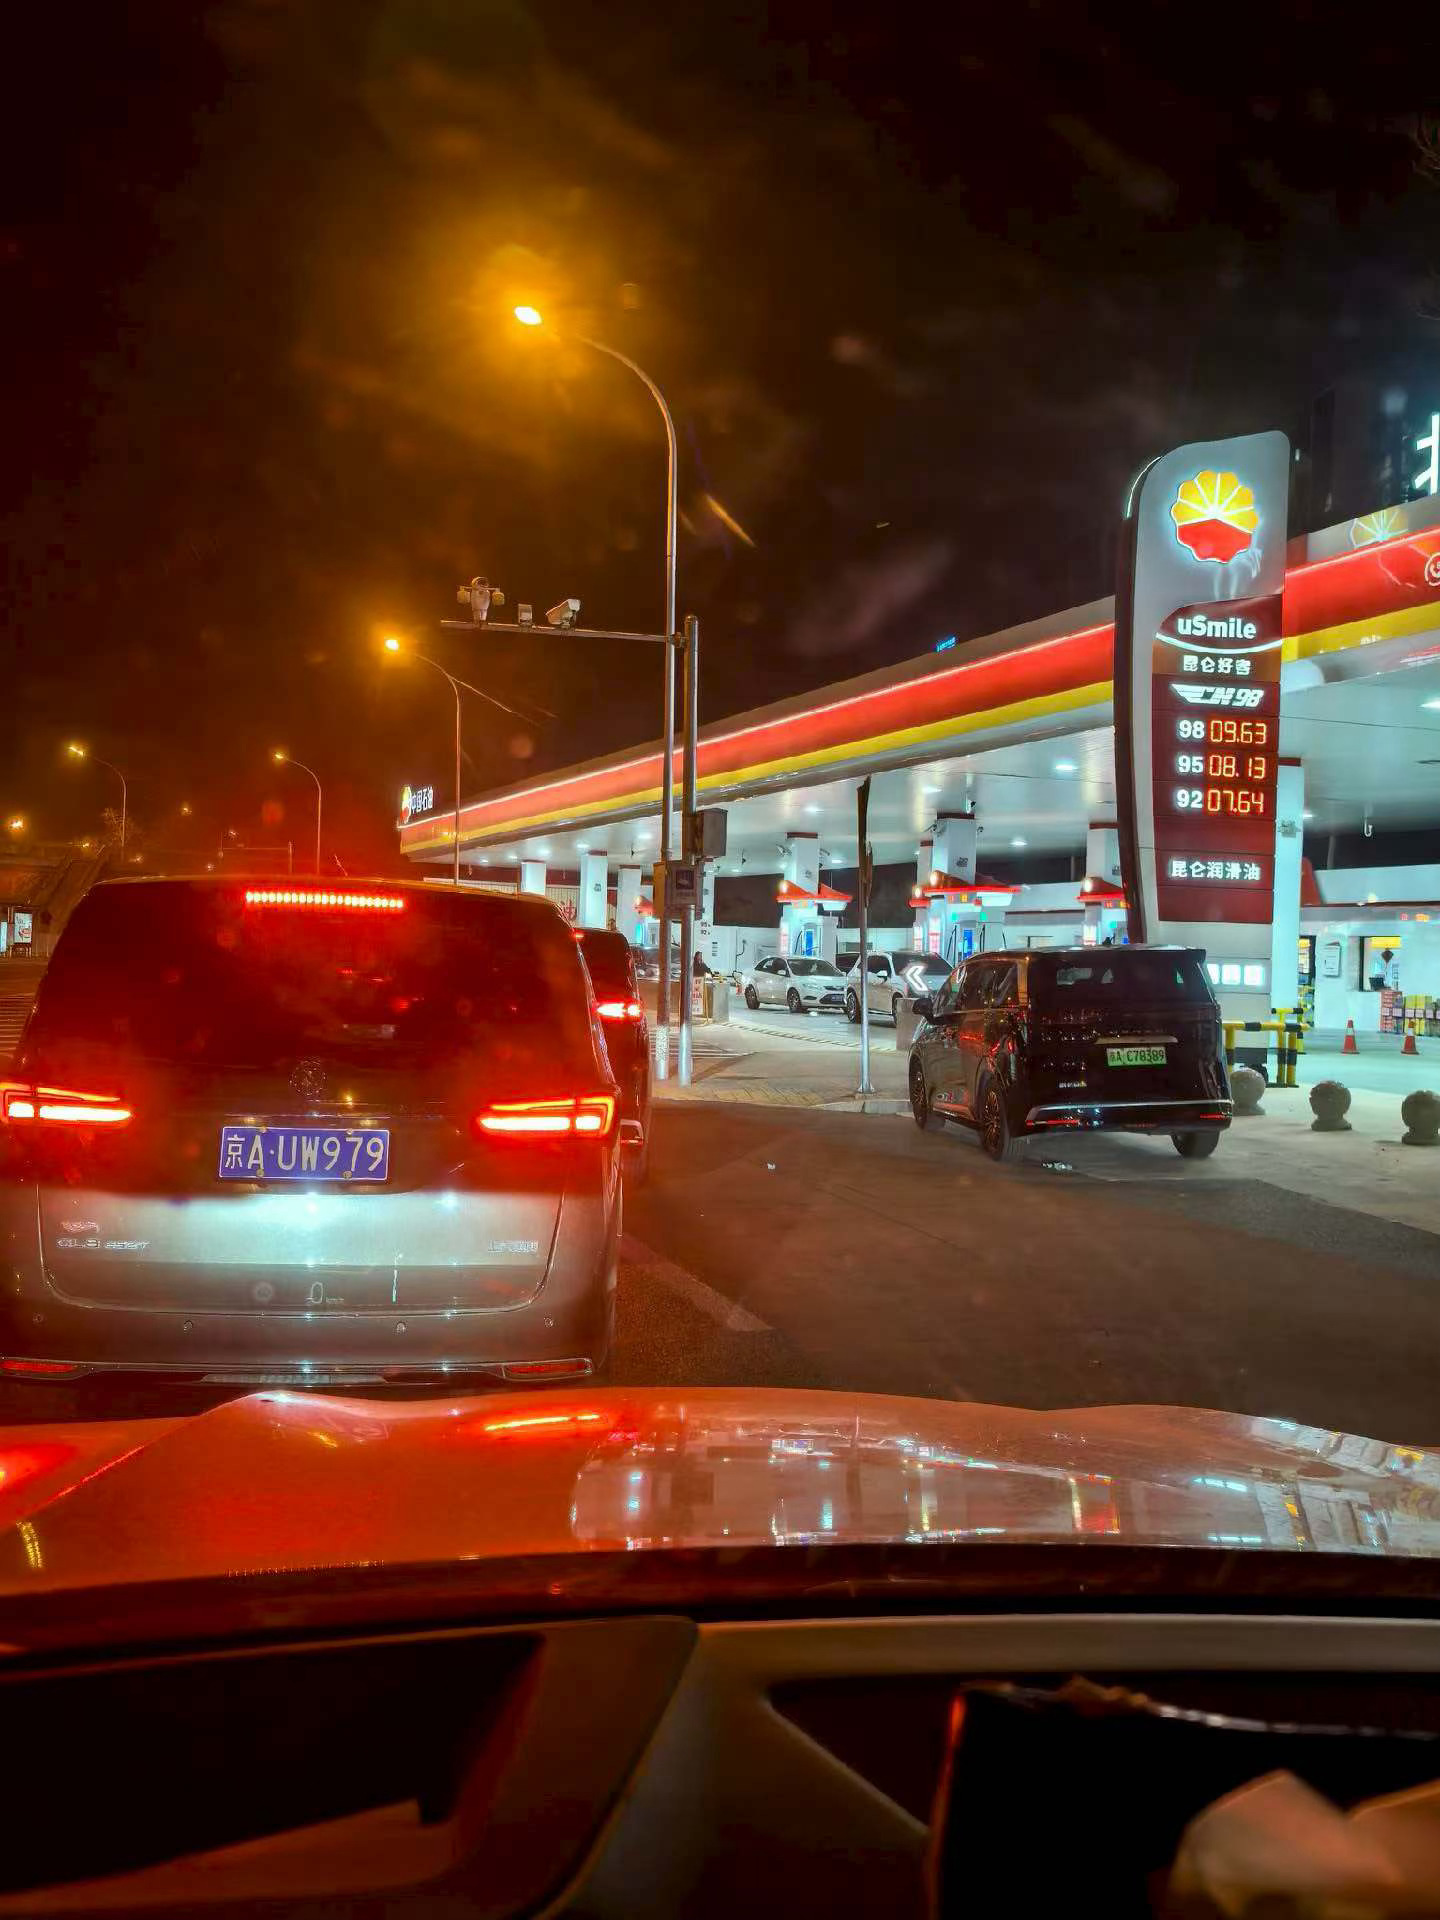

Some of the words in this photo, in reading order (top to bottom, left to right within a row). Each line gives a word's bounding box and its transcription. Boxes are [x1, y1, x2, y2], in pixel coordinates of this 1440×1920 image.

[1177, 614, 1257, 640] uSmile
[1183, 654, 1252, 676] 昆仑好客
[1178, 719, 1205, 739] 98
[1210, 719, 1267, 744] 09.63
[1177, 755, 1204, 774] 95
[1209, 755, 1266, 779] 08.13
[1176, 789, 1204, 809] 92
[1207, 789, 1265, 813] 07.64
[1171, 860, 1262, 881] 昆仑润滑油
